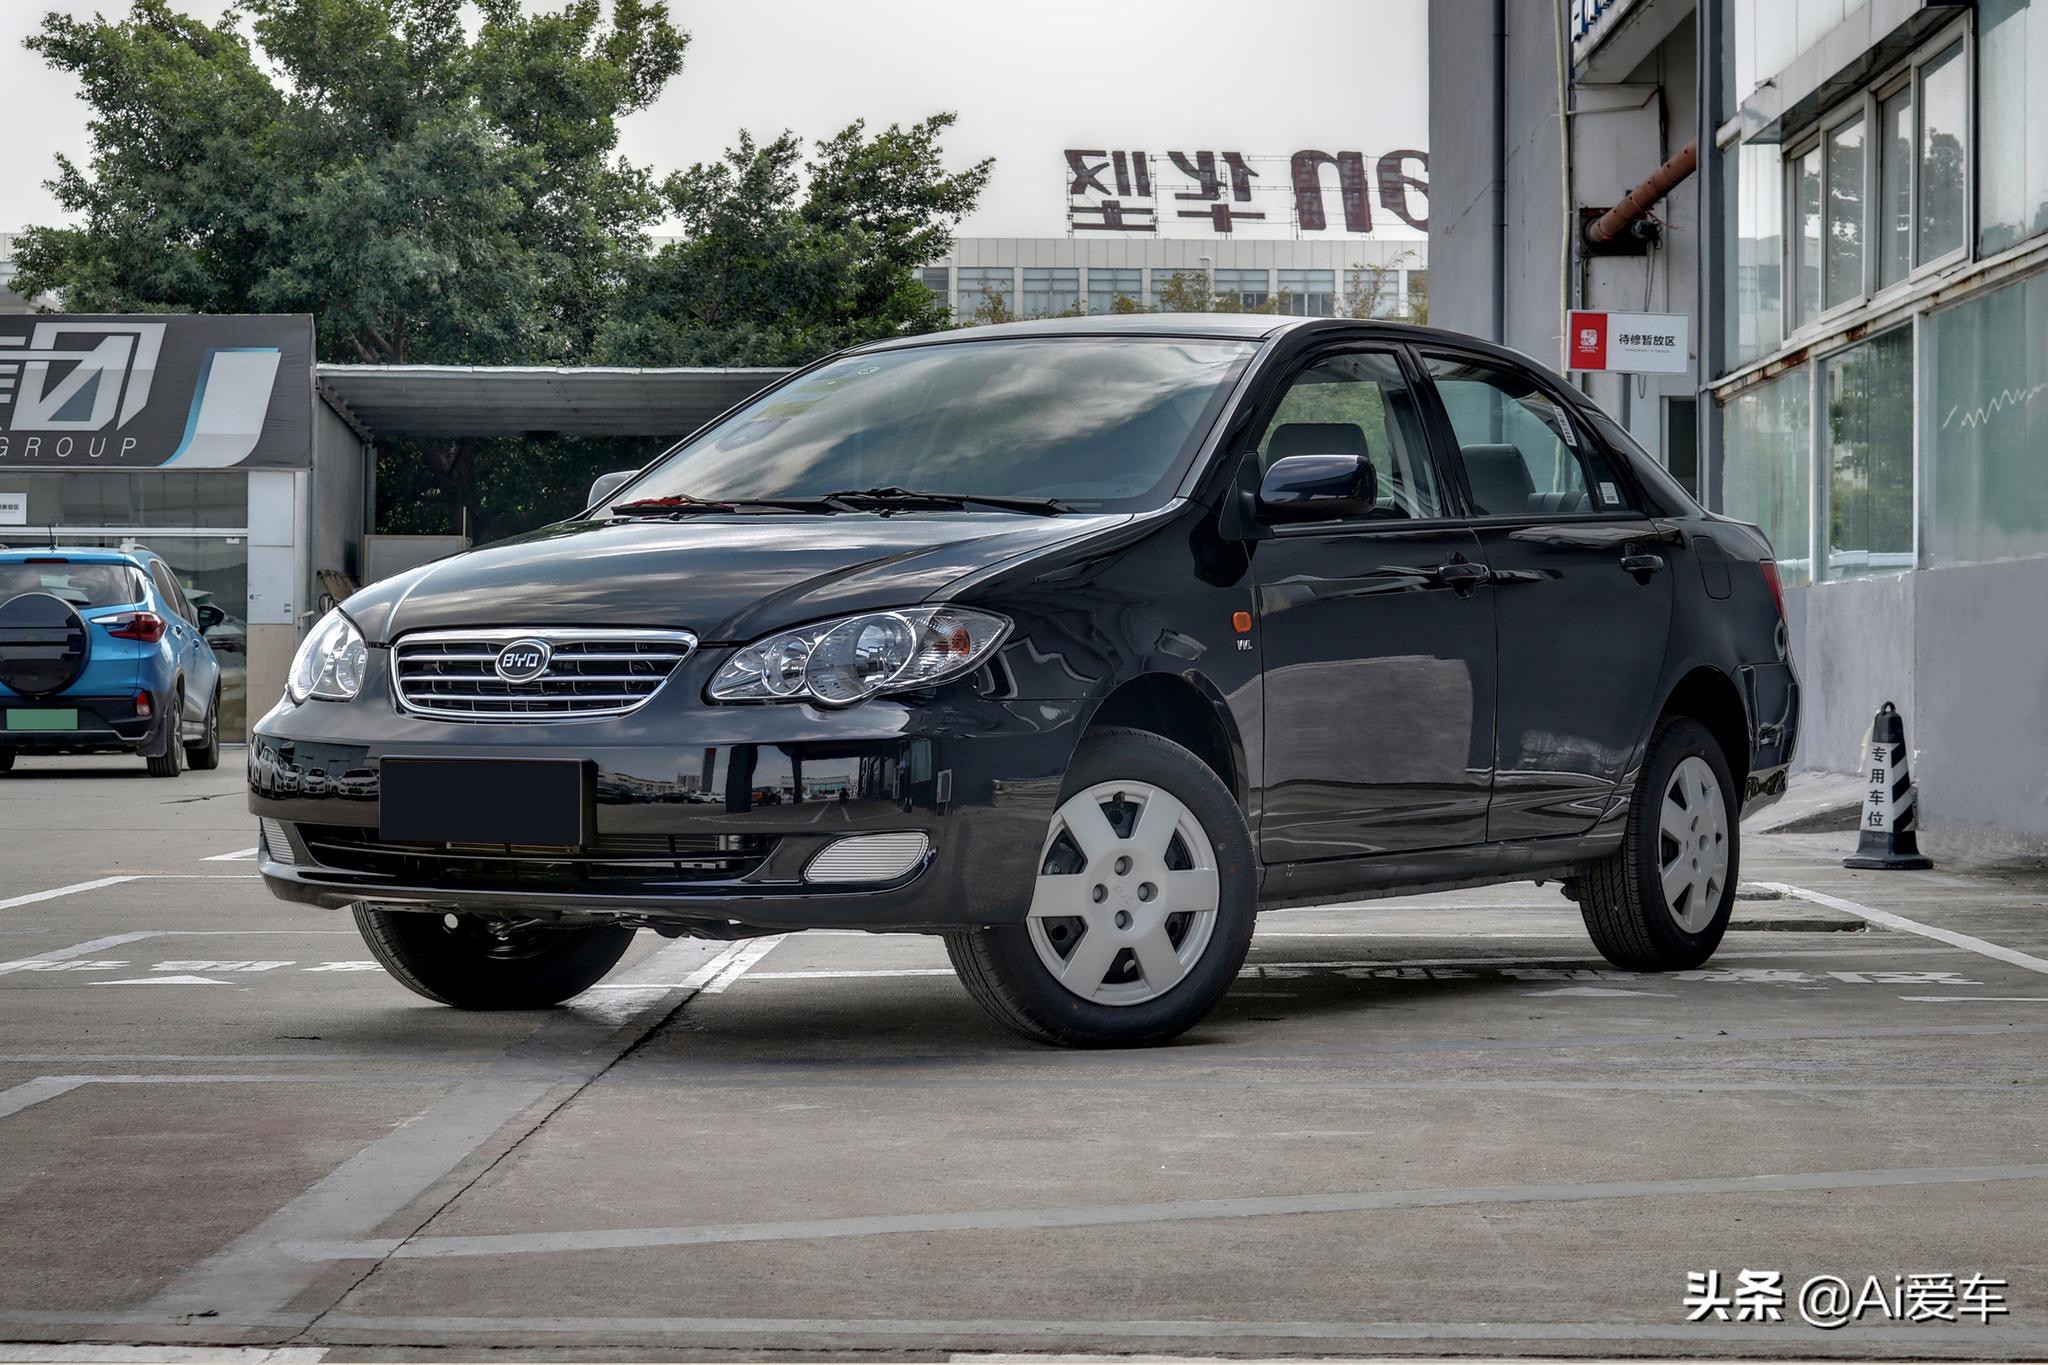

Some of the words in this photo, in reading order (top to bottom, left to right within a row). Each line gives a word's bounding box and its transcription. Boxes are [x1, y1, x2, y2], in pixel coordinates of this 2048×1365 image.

[1618, 333, 1676, 347] 待修暂放区
[502, 653, 540, 668] BYD
[1867, 746, 1887, 827] 专用车位
